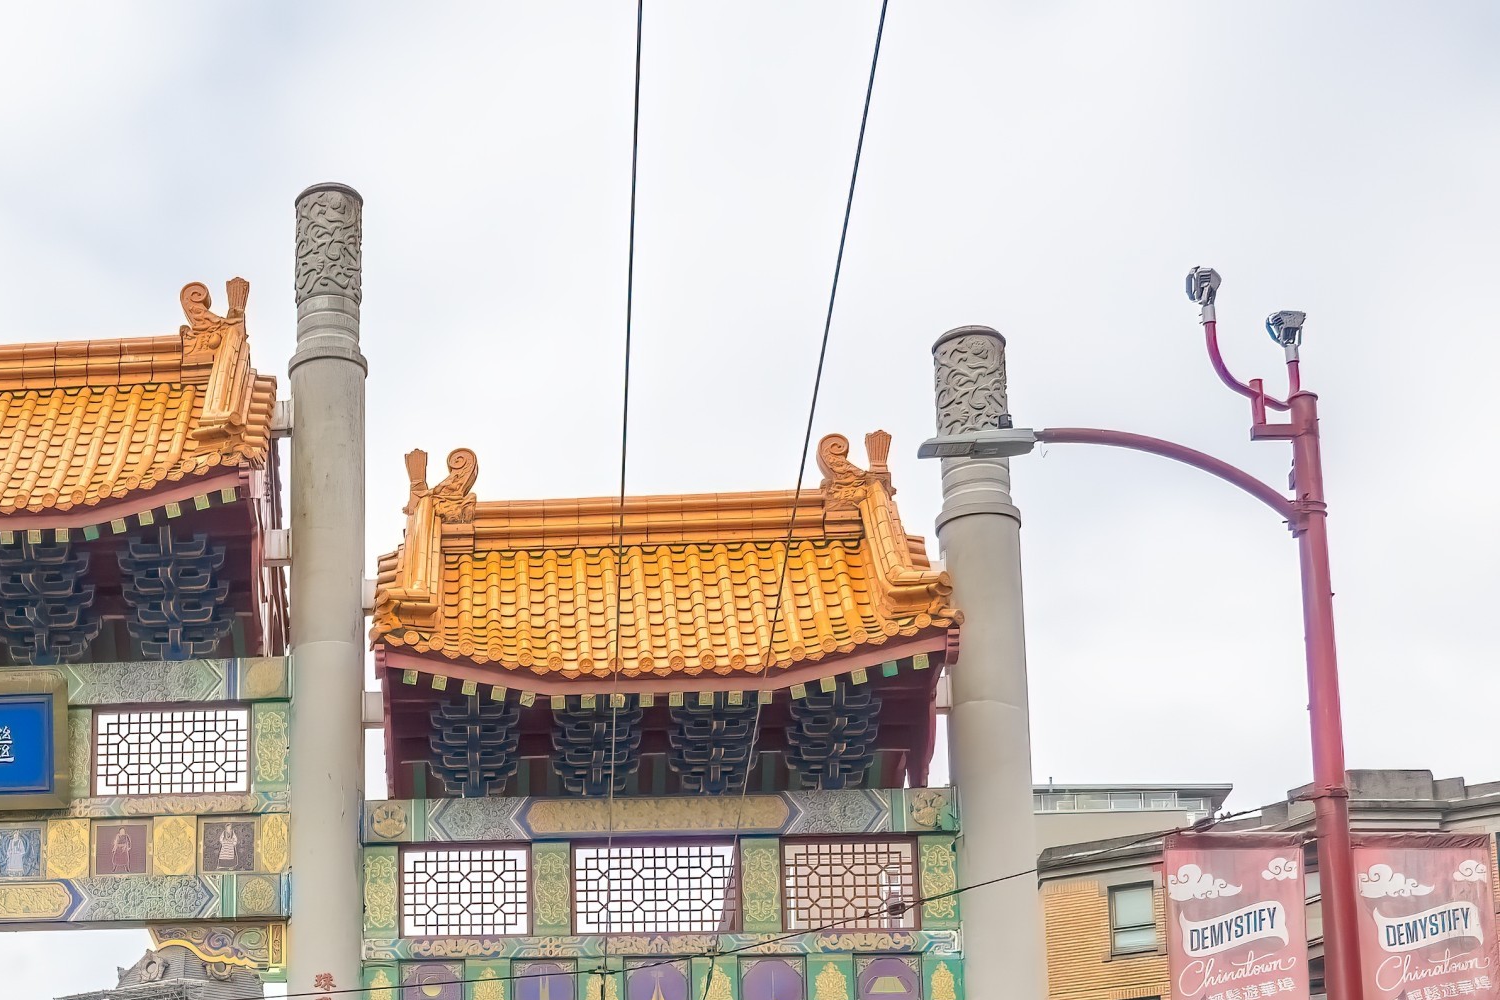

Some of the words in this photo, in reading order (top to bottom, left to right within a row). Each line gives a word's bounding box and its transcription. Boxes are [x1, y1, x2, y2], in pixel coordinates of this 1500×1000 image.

[1190, 907, 1276, 952] DEMYSTIFY
[1385, 907, 1470, 947] DEMYSTIFY
[1179, 950, 1296, 996] Chinatown
[1376, 948, 1490, 991] Chinatown
